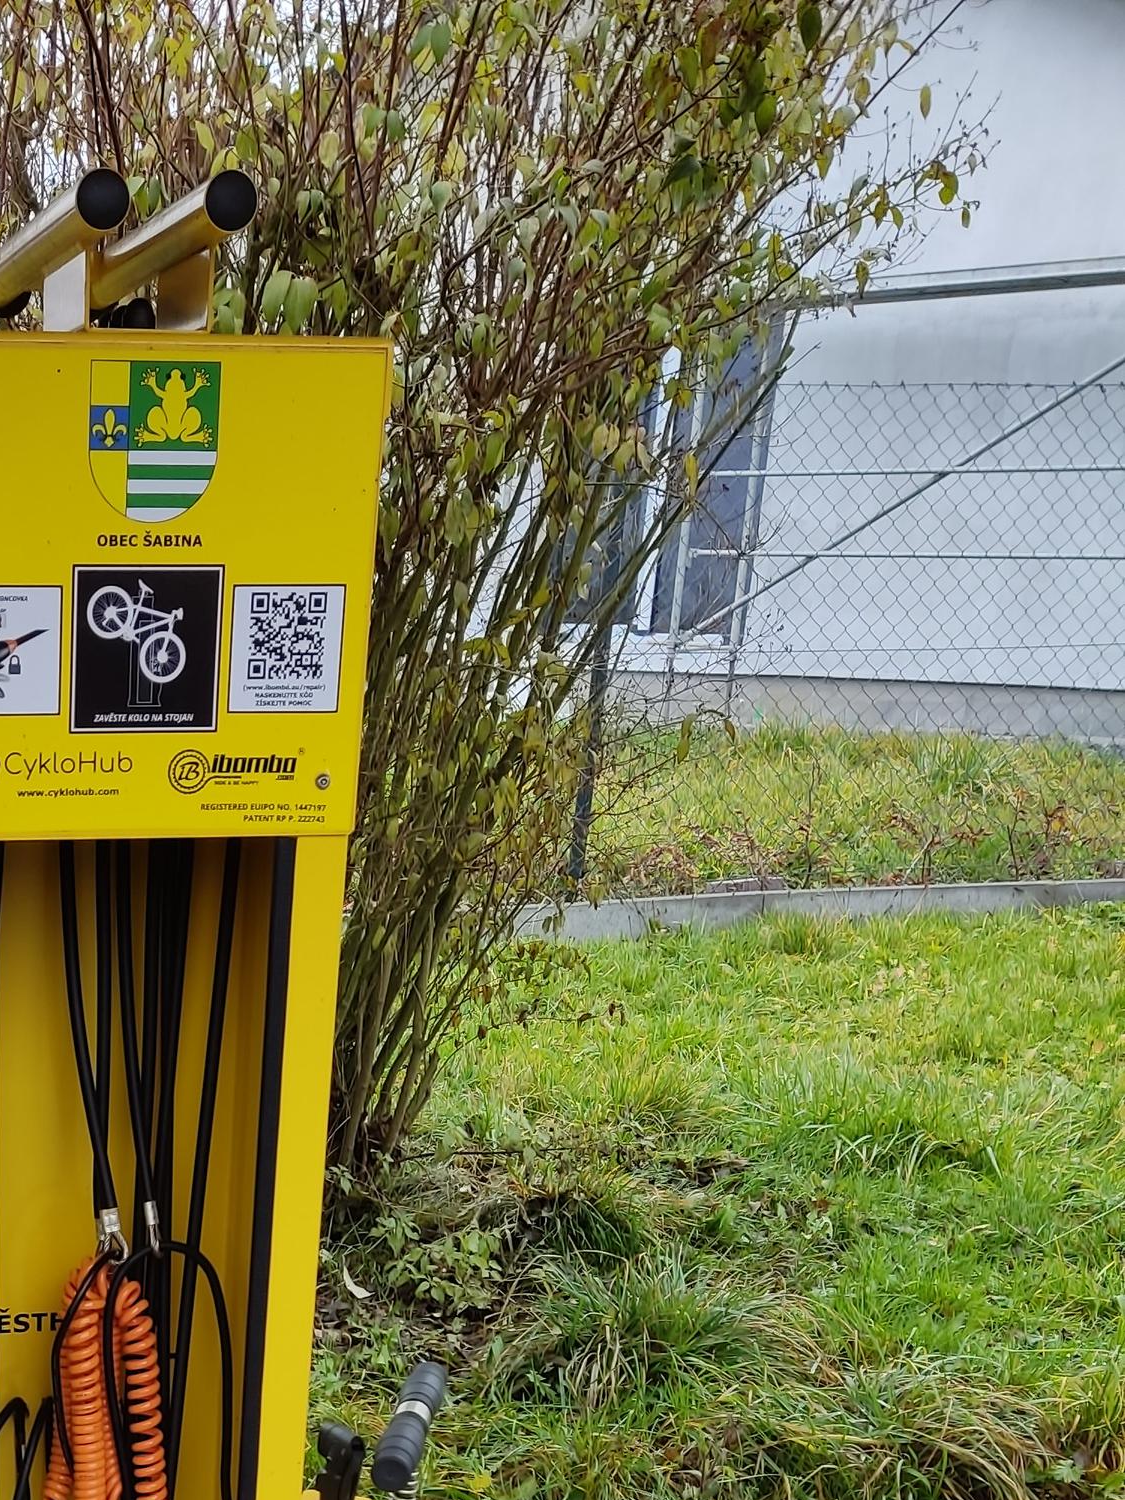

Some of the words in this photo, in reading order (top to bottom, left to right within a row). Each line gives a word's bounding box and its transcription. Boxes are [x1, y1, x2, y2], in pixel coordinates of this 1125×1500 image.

[97, 534, 139, 547] OBEC
[142, 530, 203, 547] ŠABINA
[93, 712, 127, 723] ZAVĚSTE
[128, 713, 150, 722] KOLO
[151, 713, 163, 722] NA
[164, 713, 194, 724] STOJAN
[4, 751, 133, 781] CykloHub
[211, 754, 297, 773] ibombo
[17, 787, 119, 799] www.cyklohub.com
[200, 803, 248, 811] REGISTERED
